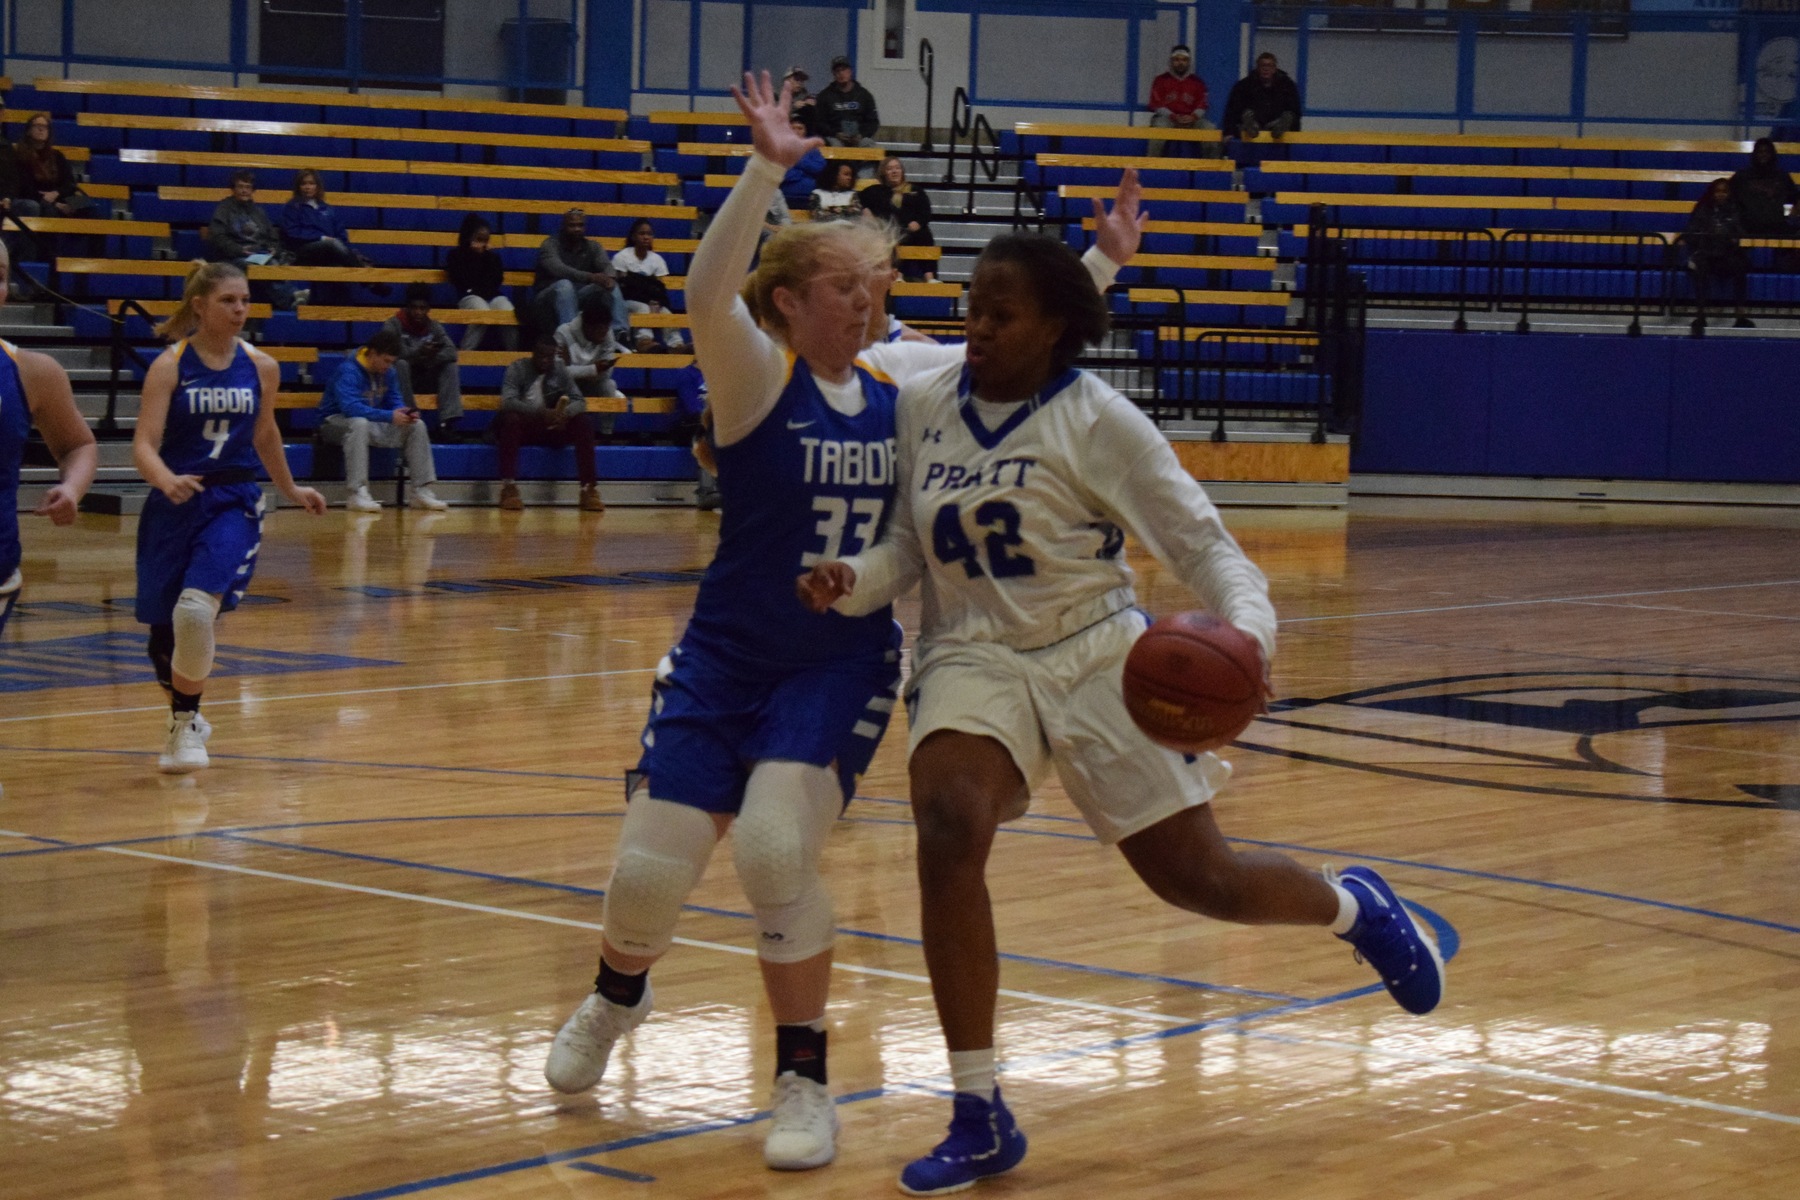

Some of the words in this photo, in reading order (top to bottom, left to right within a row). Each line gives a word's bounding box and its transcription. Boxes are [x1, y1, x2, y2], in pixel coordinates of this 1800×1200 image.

[186, 386, 254, 414] TABOR
[202, 419, 230, 459] 4
[921, 458, 1036, 491] PRATT
[801, 496, 884, 568] 33
[932, 500, 1036, 579] 42
